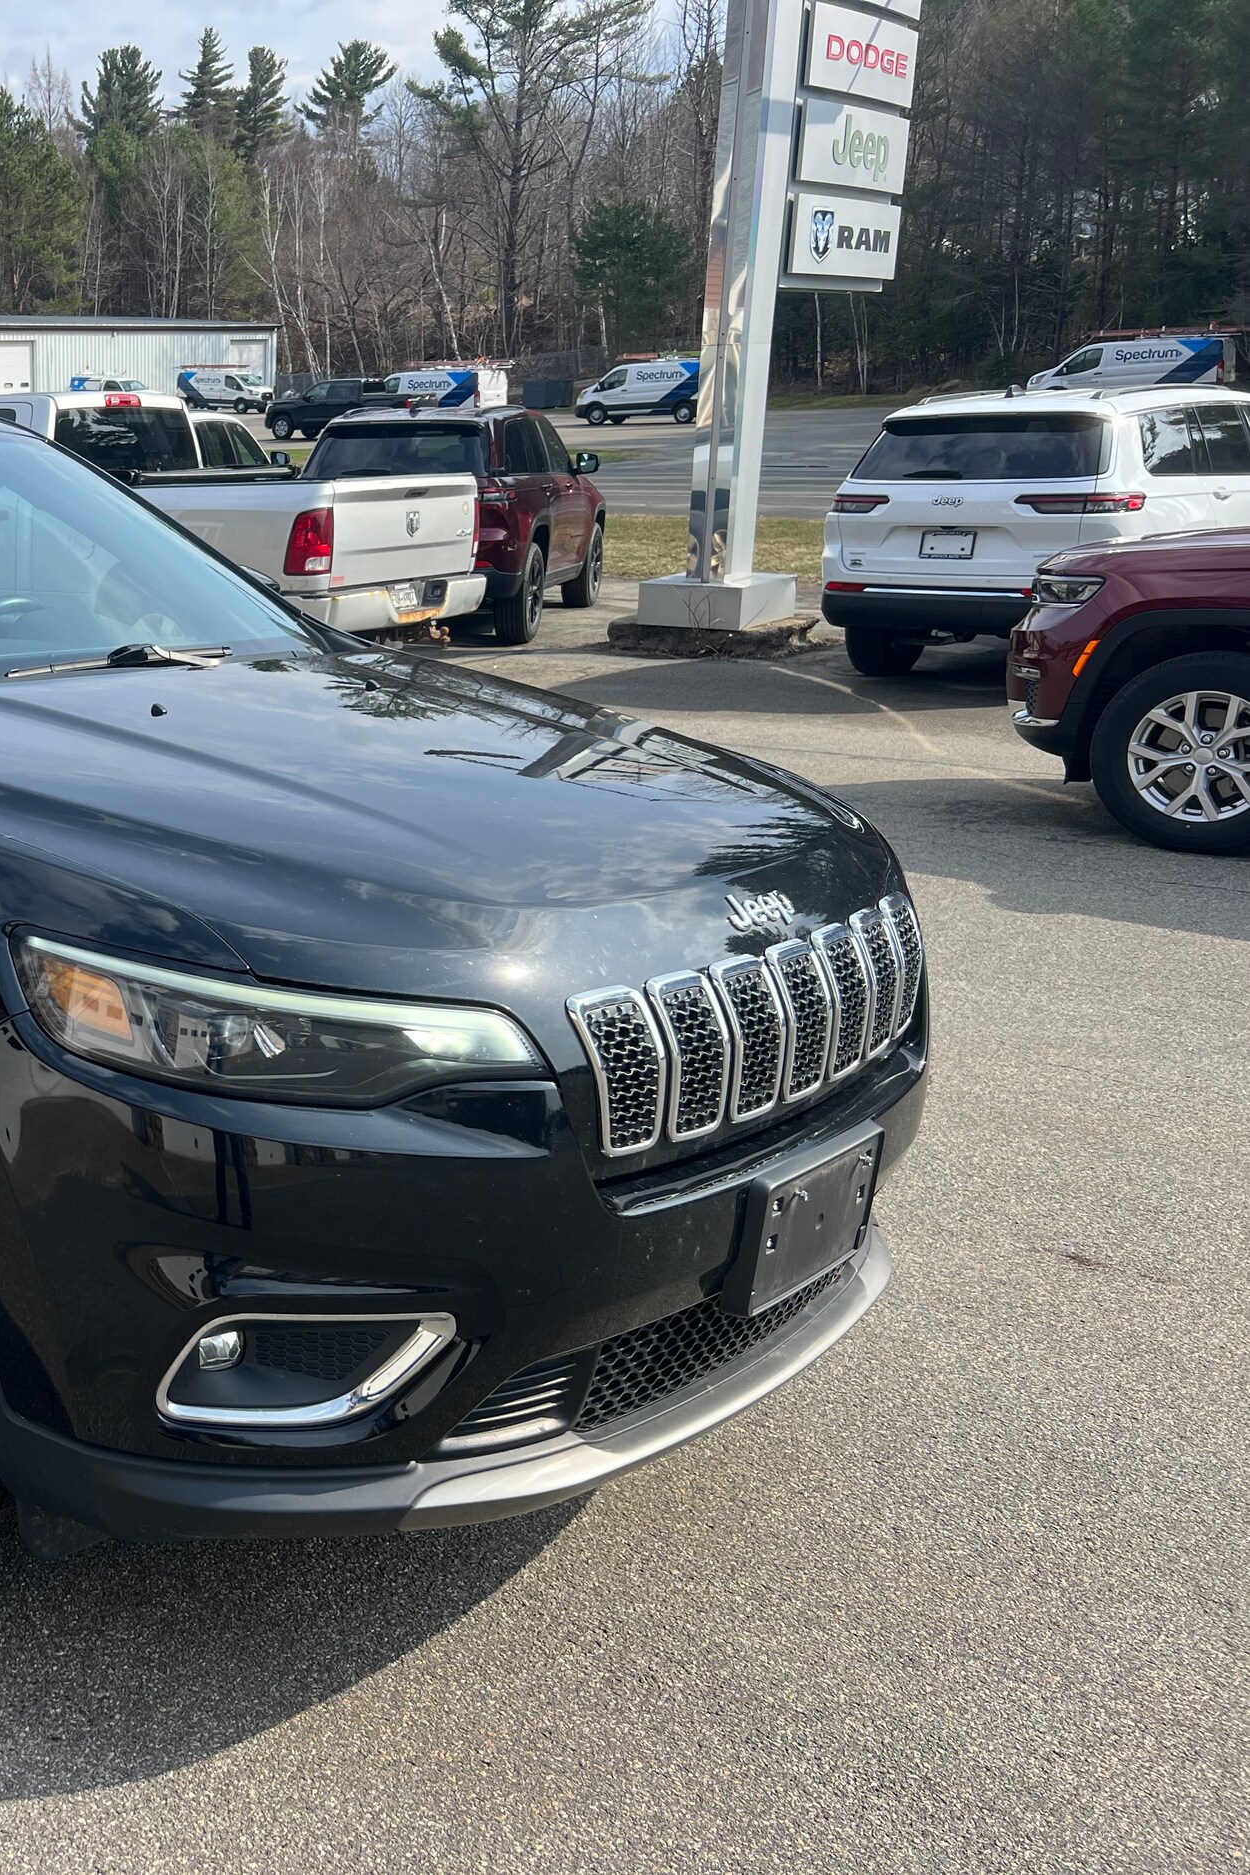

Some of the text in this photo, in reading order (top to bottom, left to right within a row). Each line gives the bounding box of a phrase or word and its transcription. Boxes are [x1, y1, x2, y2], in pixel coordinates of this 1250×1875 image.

[826, 34, 908, 79] DODGE
[832, 113, 890, 182] Jeep
[836, 225, 891, 254] RAM
[1114, 348, 1179, 363] Spectrum
[193, 376, 221, 385] Spectrum
[636, 370, 682, 382] Spectrum
[407, 379, 449, 391] Spectrum
[932, 495, 964, 507] Jeep
[724, 889, 795, 932] Jeep
